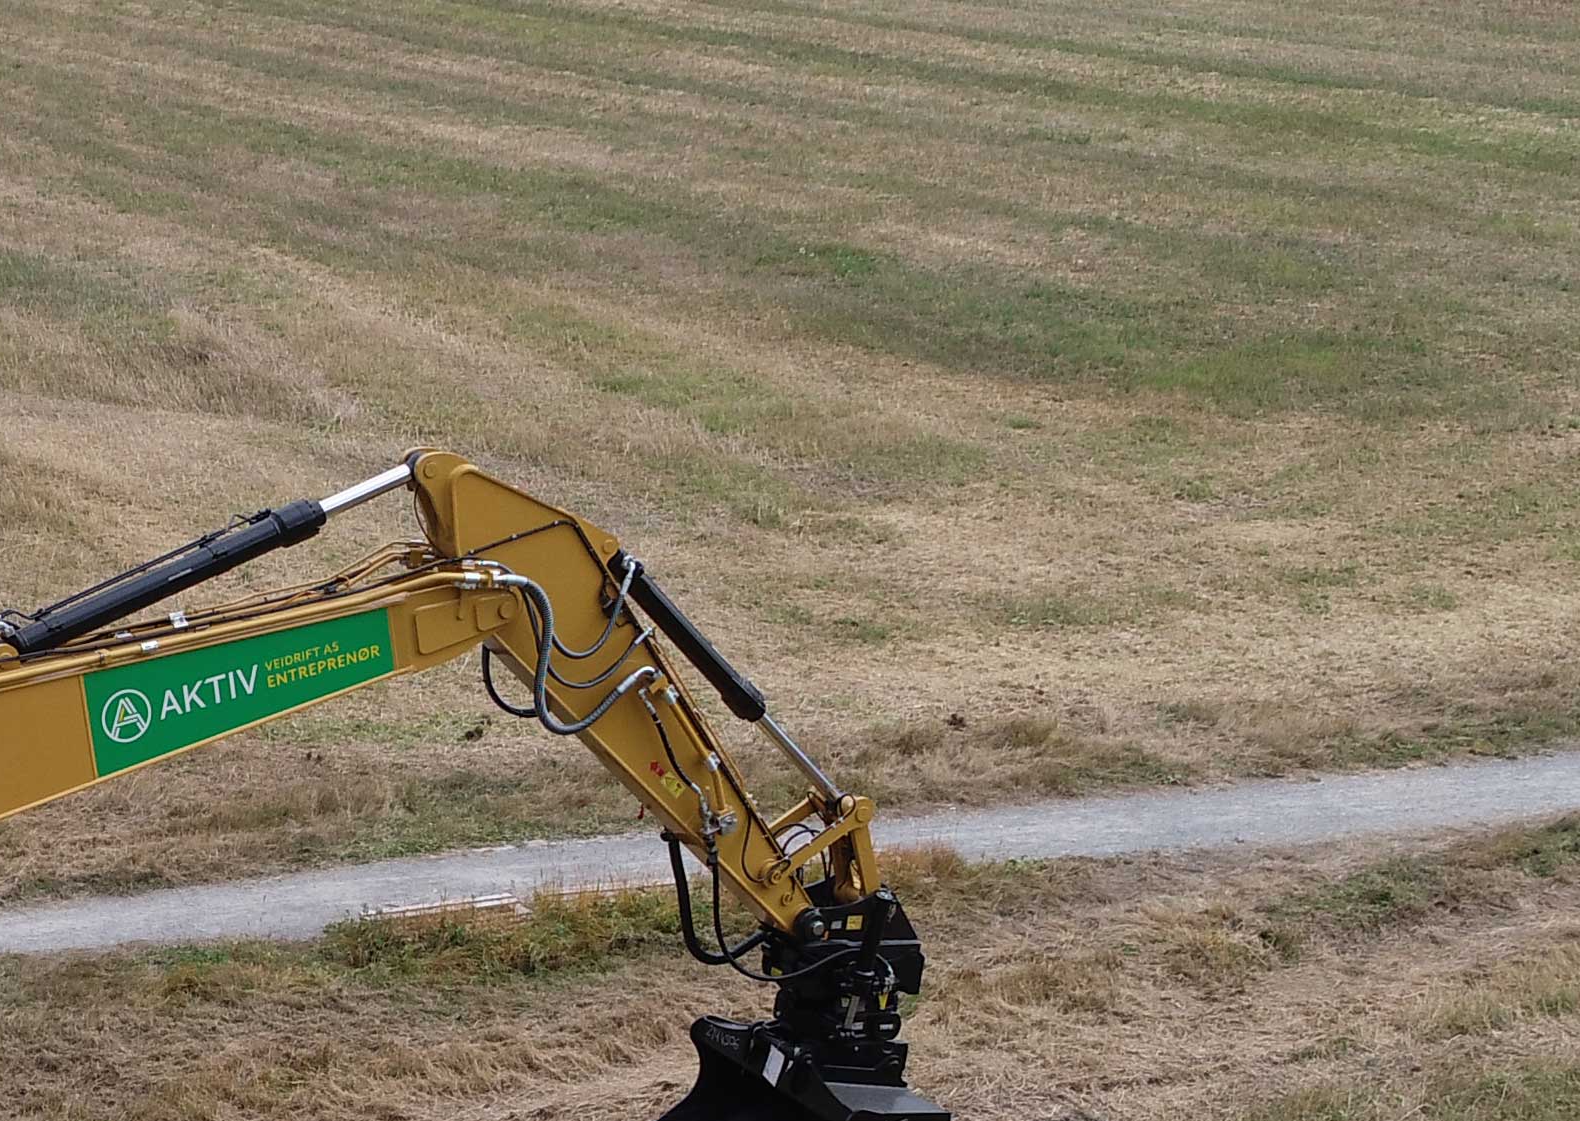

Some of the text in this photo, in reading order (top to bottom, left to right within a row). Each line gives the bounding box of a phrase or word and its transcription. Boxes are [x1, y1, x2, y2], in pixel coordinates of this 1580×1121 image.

[264, 641, 340, 672] VEIDRIFT AS
[266, 644, 381, 688] ENTREPRENØR
[159, 663, 259, 721] AKTIV
